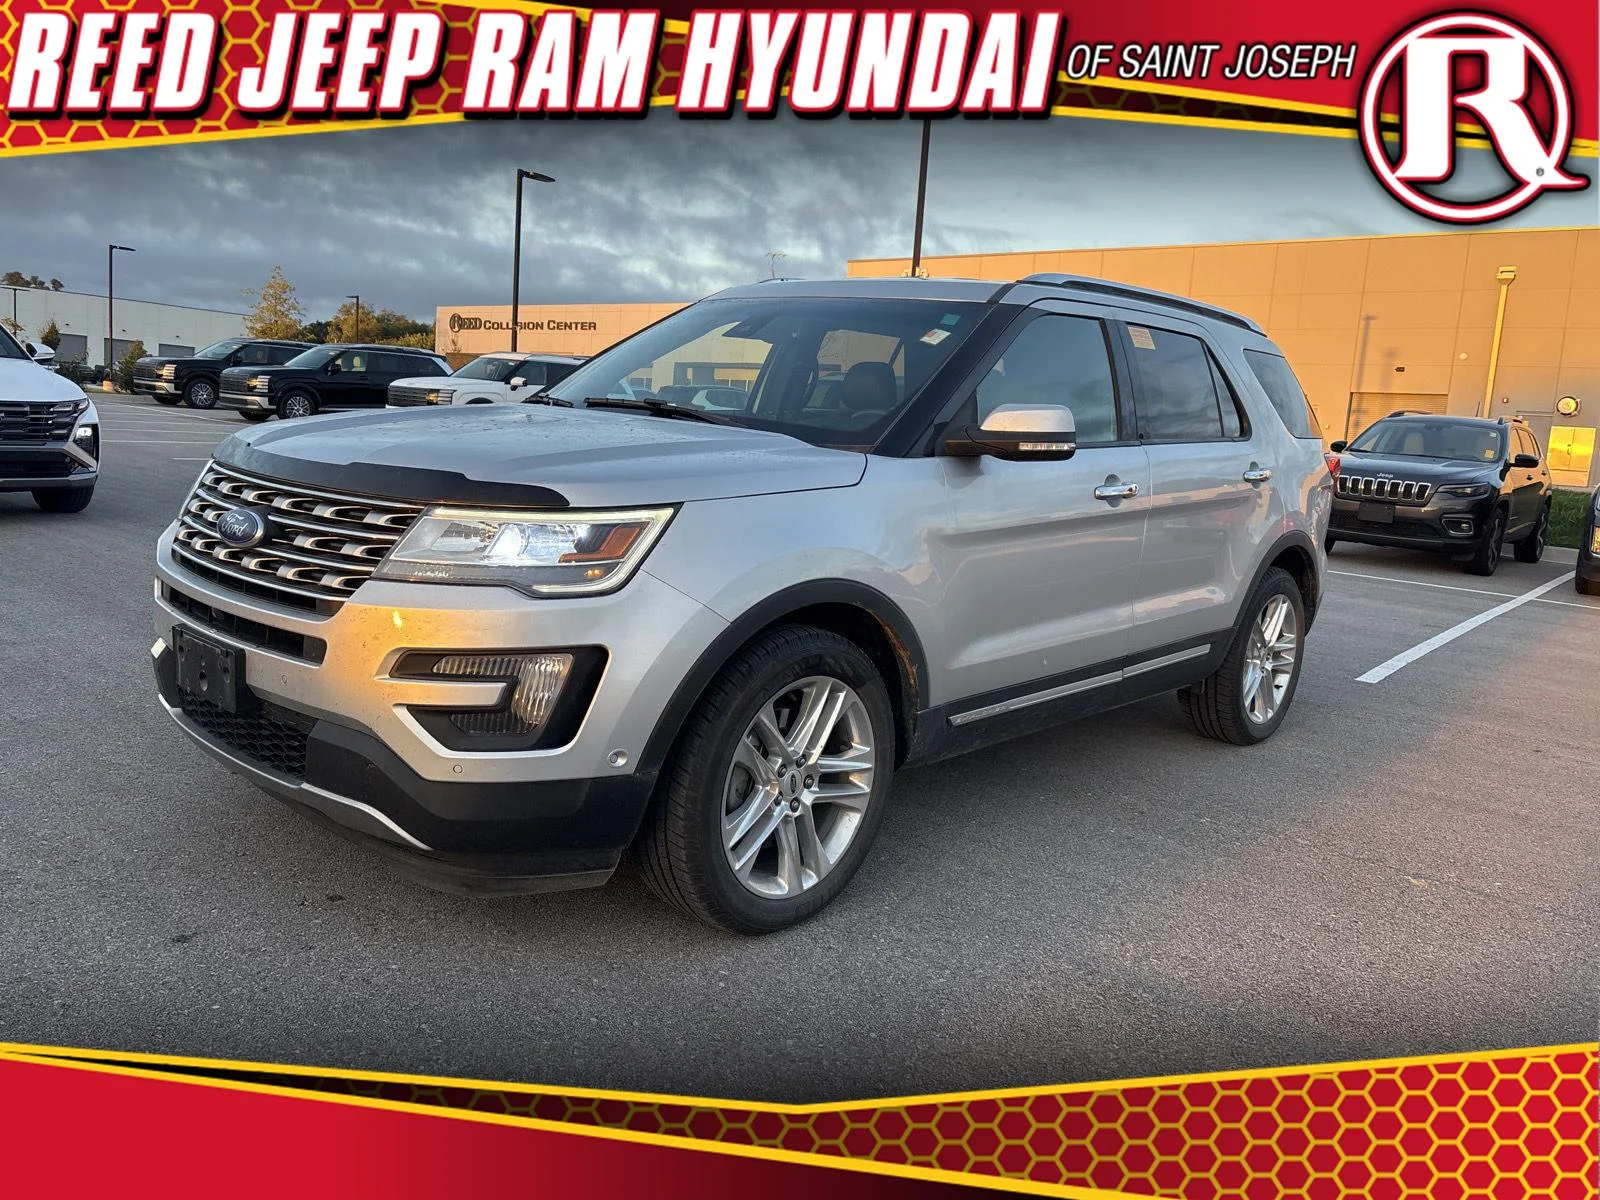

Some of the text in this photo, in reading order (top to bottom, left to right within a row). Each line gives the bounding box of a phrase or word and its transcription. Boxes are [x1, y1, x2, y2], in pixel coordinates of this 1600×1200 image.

[483, 319, 544, 331] COLLSION
[547, 319, 597, 331] CENTER
[221, 513, 249, 537] Ford
